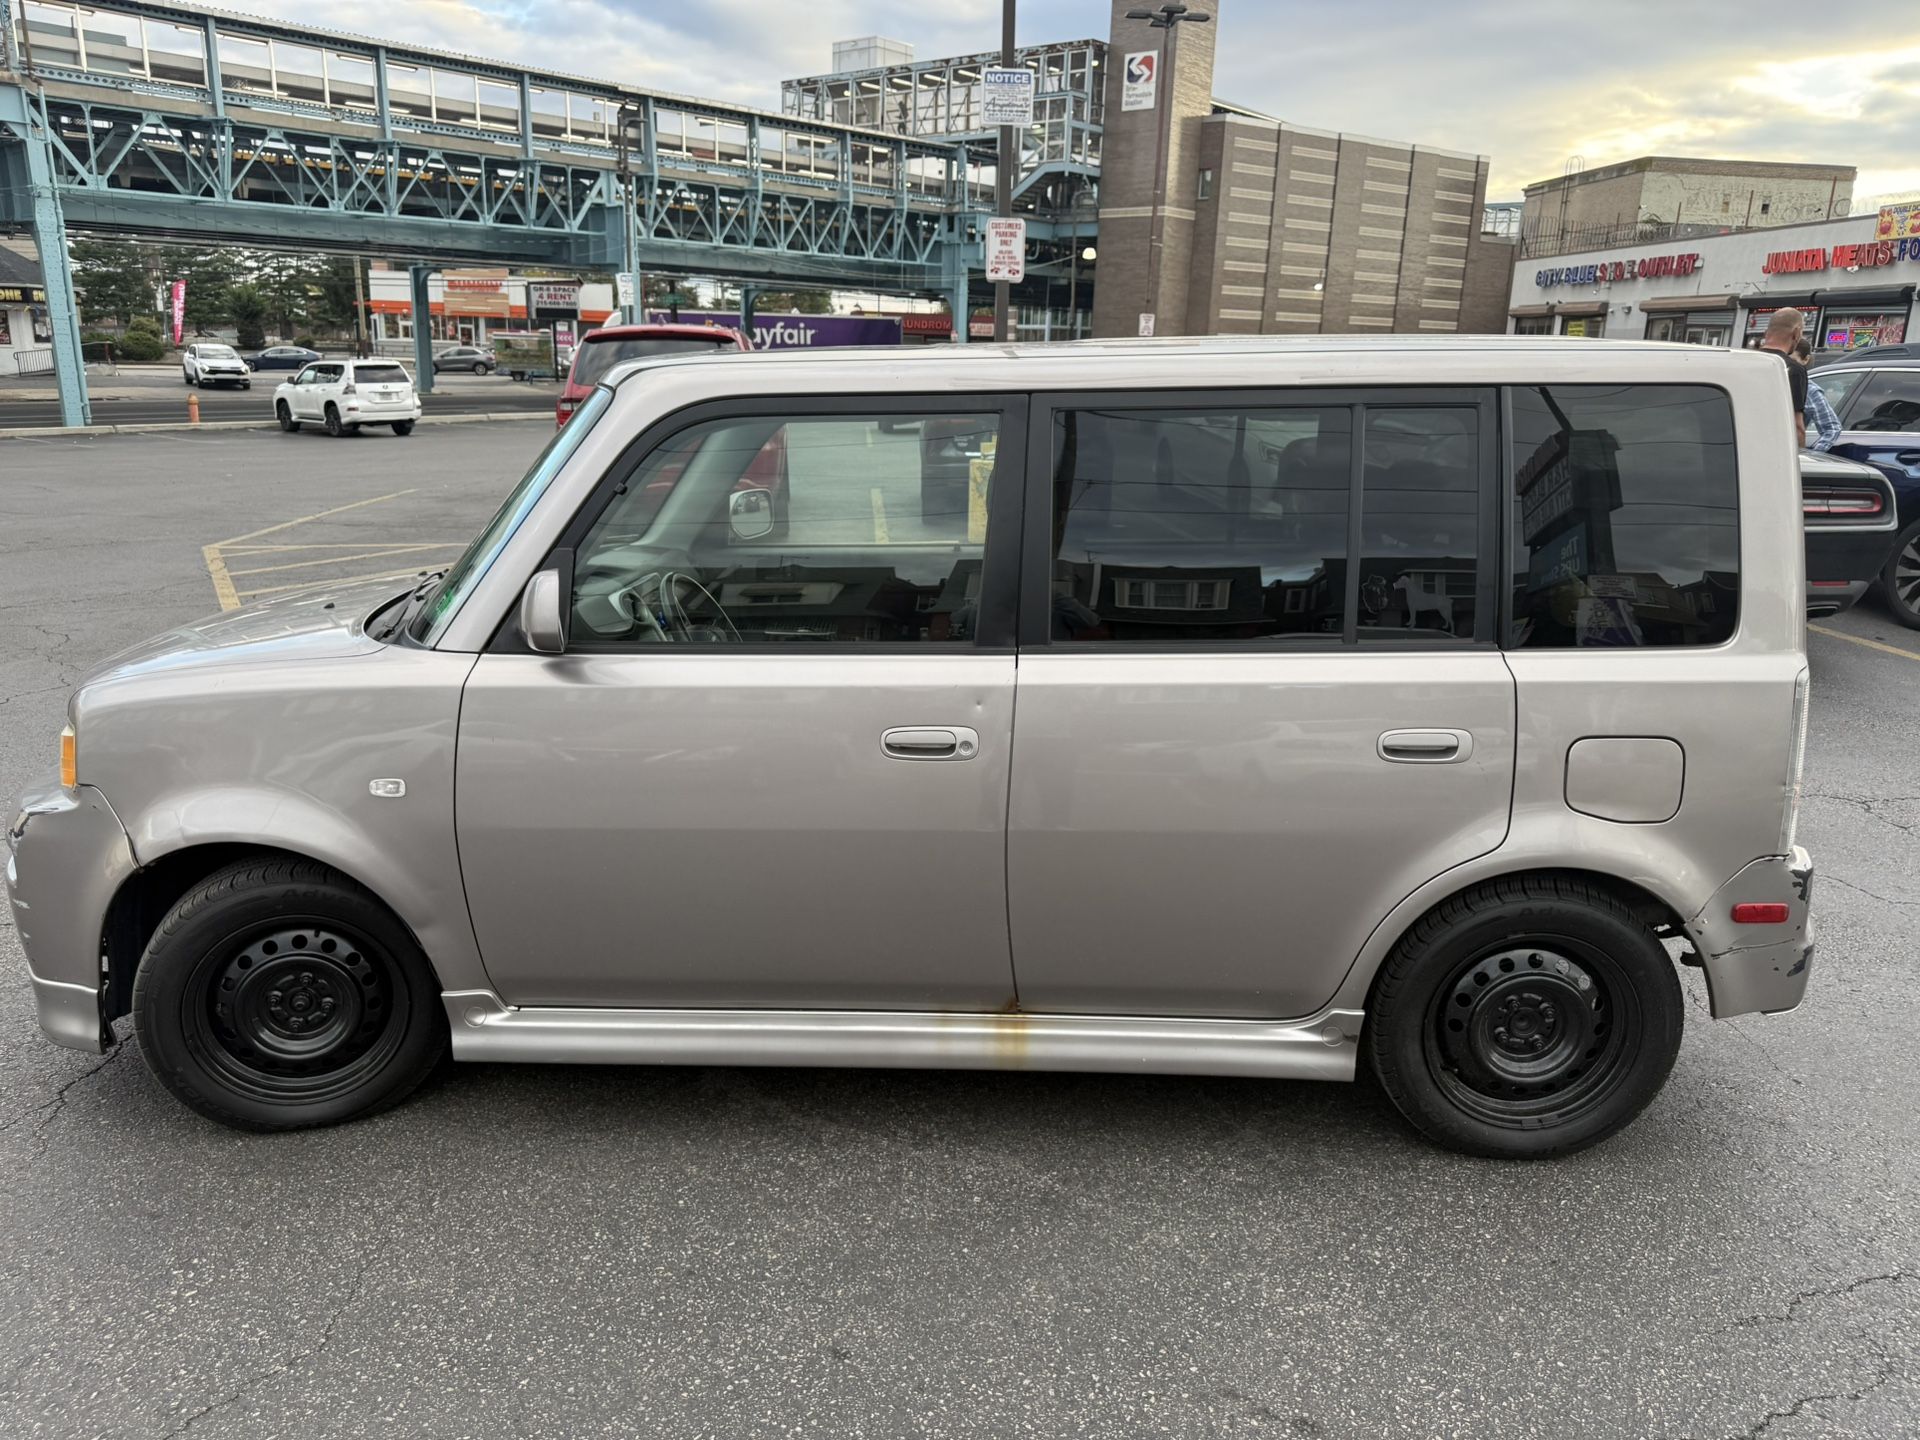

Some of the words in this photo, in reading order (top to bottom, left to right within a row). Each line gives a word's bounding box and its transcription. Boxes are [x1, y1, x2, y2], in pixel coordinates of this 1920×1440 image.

[986, 73, 1029, 84] NOTICE
[991, 222, 1021, 230] CUSTOMERS
[1536, 268, 1563, 287] CITY
[1564, 264, 1596, 284] BLUE
[1599, 260, 1636, 282] SHOE
[1638, 254, 1698, 278] OUTLET
[1762, 248, 1826, 274] JUNIATA
[1831, 240, 1893, 267] MEATS
[752, 322, 815, 350] ayfair
